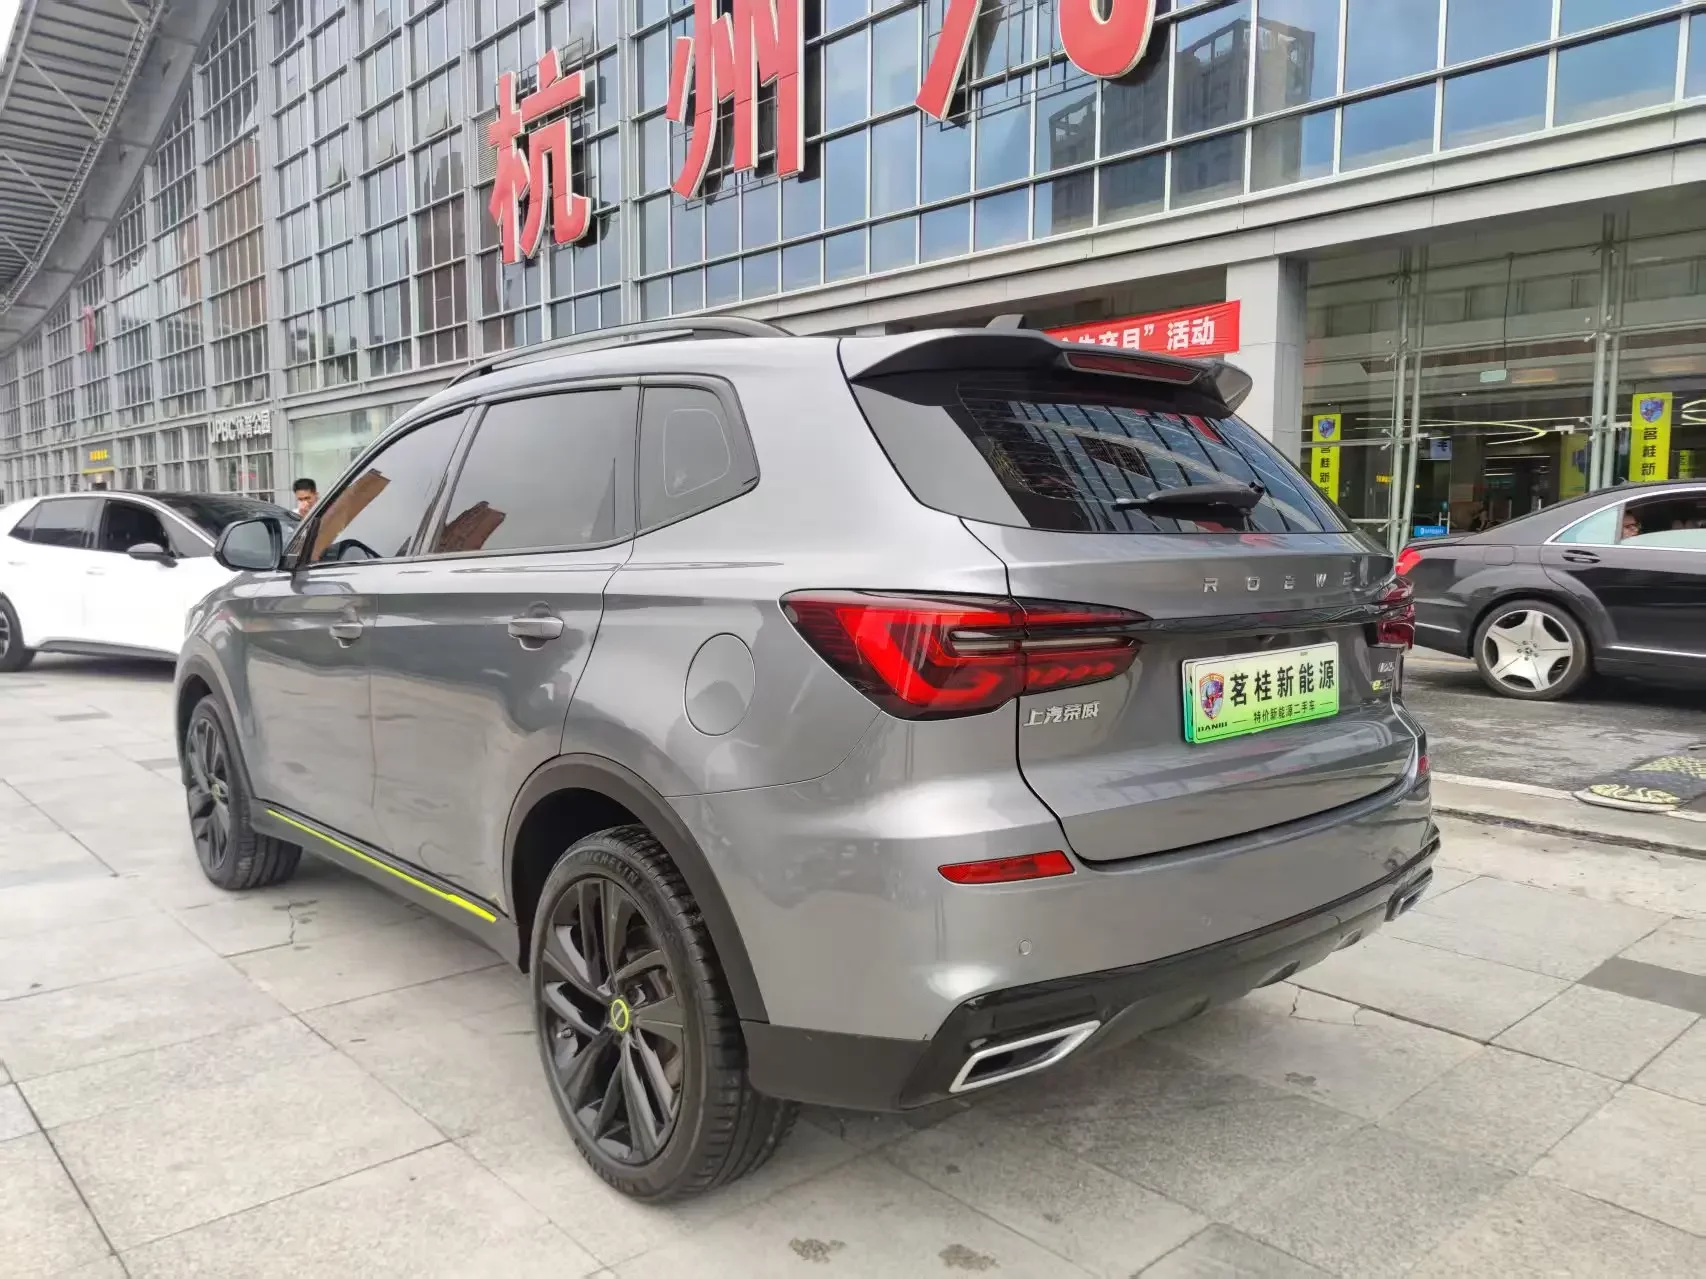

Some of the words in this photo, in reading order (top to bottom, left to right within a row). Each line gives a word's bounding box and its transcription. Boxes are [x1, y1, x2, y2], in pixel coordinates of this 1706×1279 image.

[1203, 572, 1355, 593] ROEWE
[1230, 659, 1335, 707] 茗桂新能源
[1023, 700, 1100, 726] 上汽荣威
[1253, 700, 1316, 724] 特价新能源二手车
